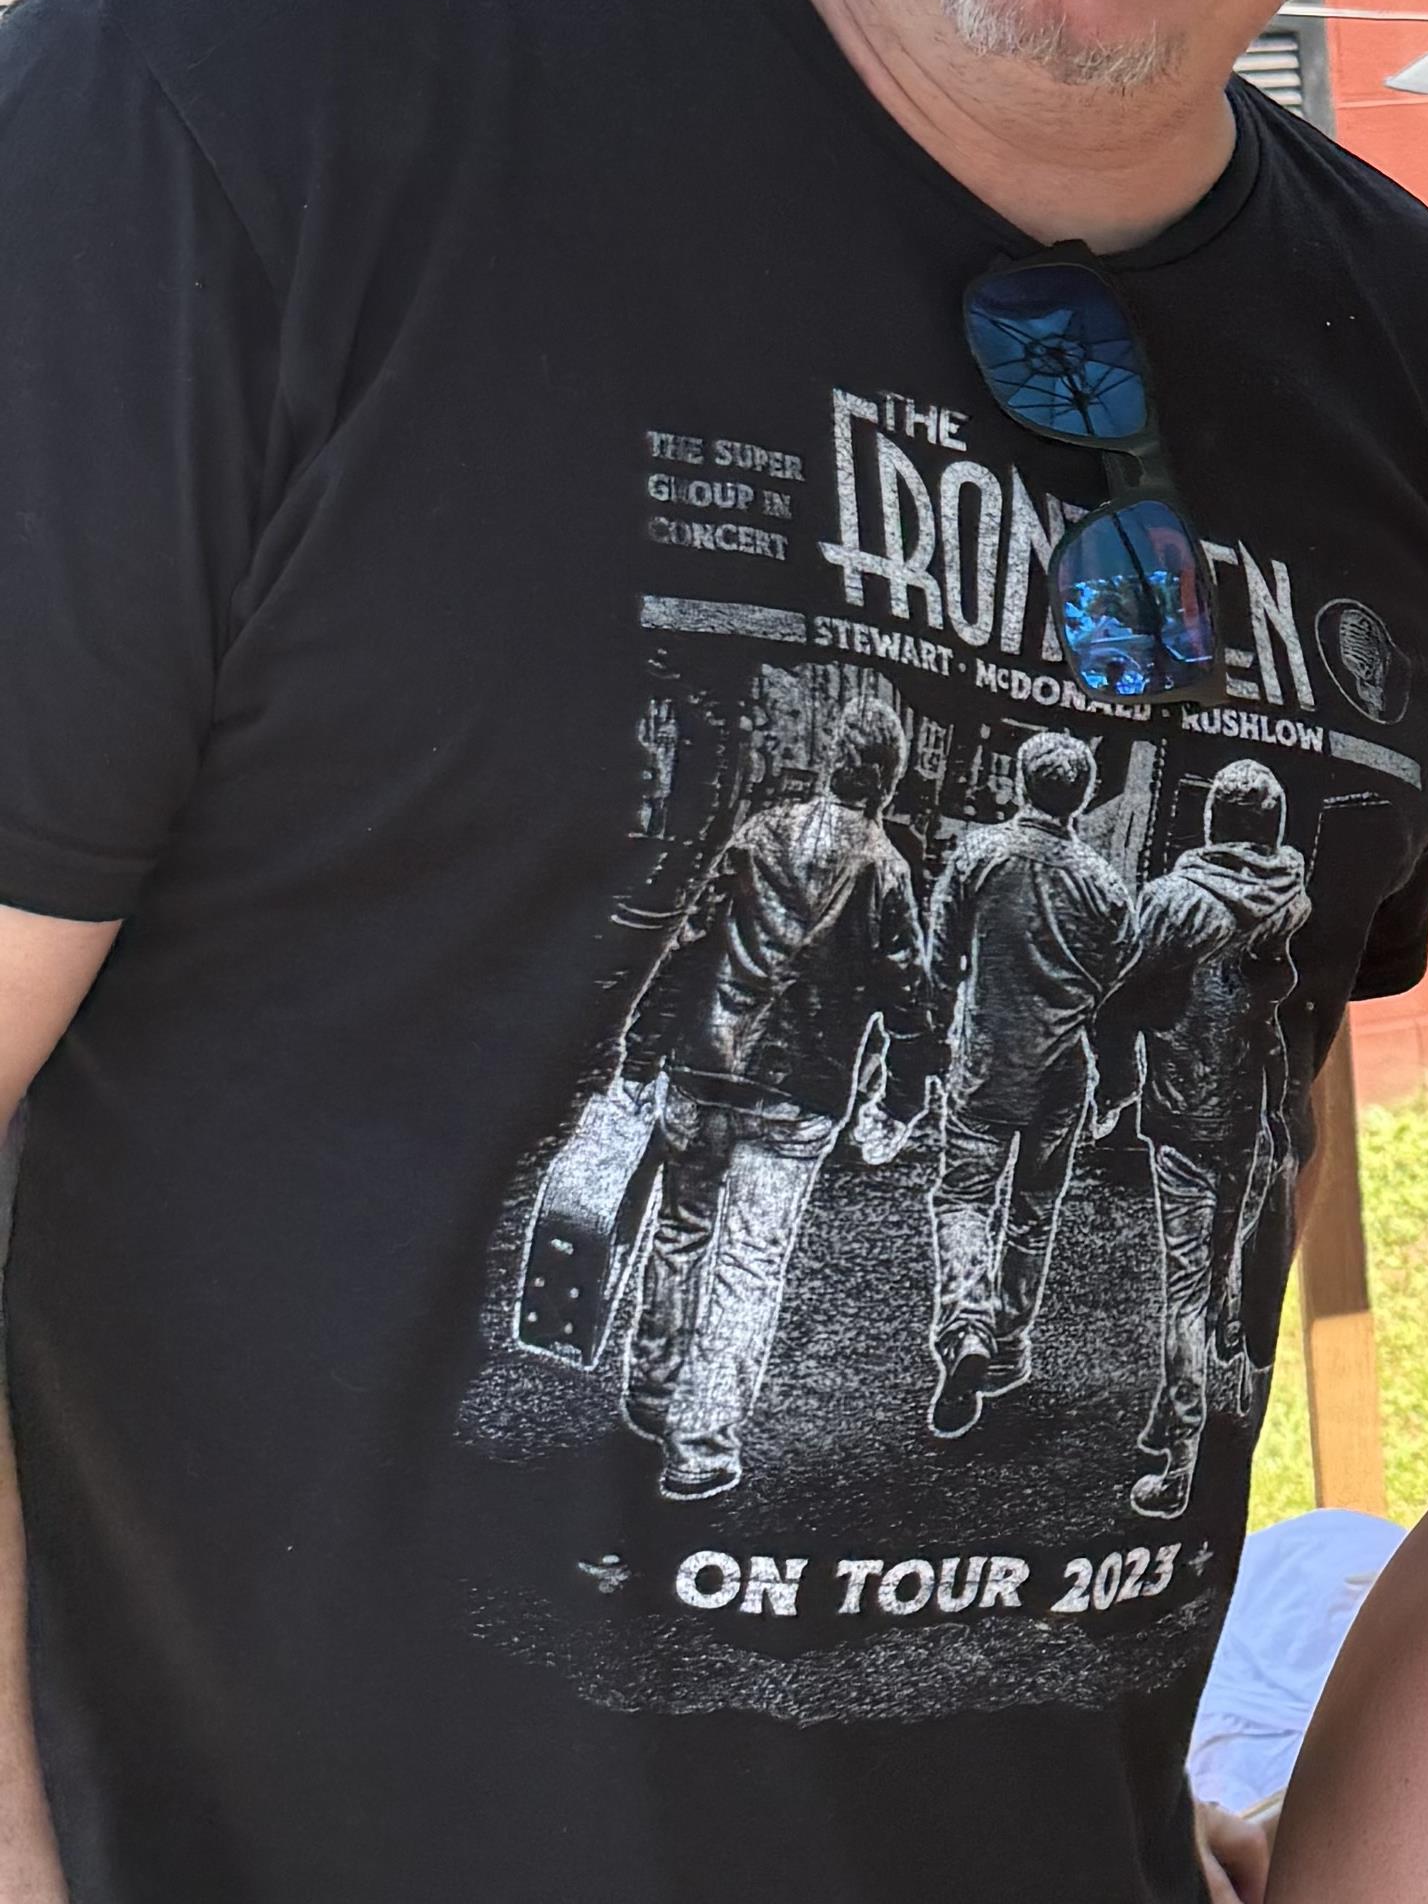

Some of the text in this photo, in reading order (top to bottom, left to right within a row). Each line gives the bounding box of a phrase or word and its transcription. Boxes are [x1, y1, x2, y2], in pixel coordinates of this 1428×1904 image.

[880, 391, 972, 452] THE
[647, 431, 805, 481] THE SUPER
[762, 490, 792, 519] IN
[649, 516, 788, 561] CONCERT
[818, 388, 1315, 710] FRONEN
[813, 616, 953, 676] STEWART
[1181, 704, 1324, 753] RUSHLOW
[675, 1542, 1183, 1616] ON TOUR 2023
